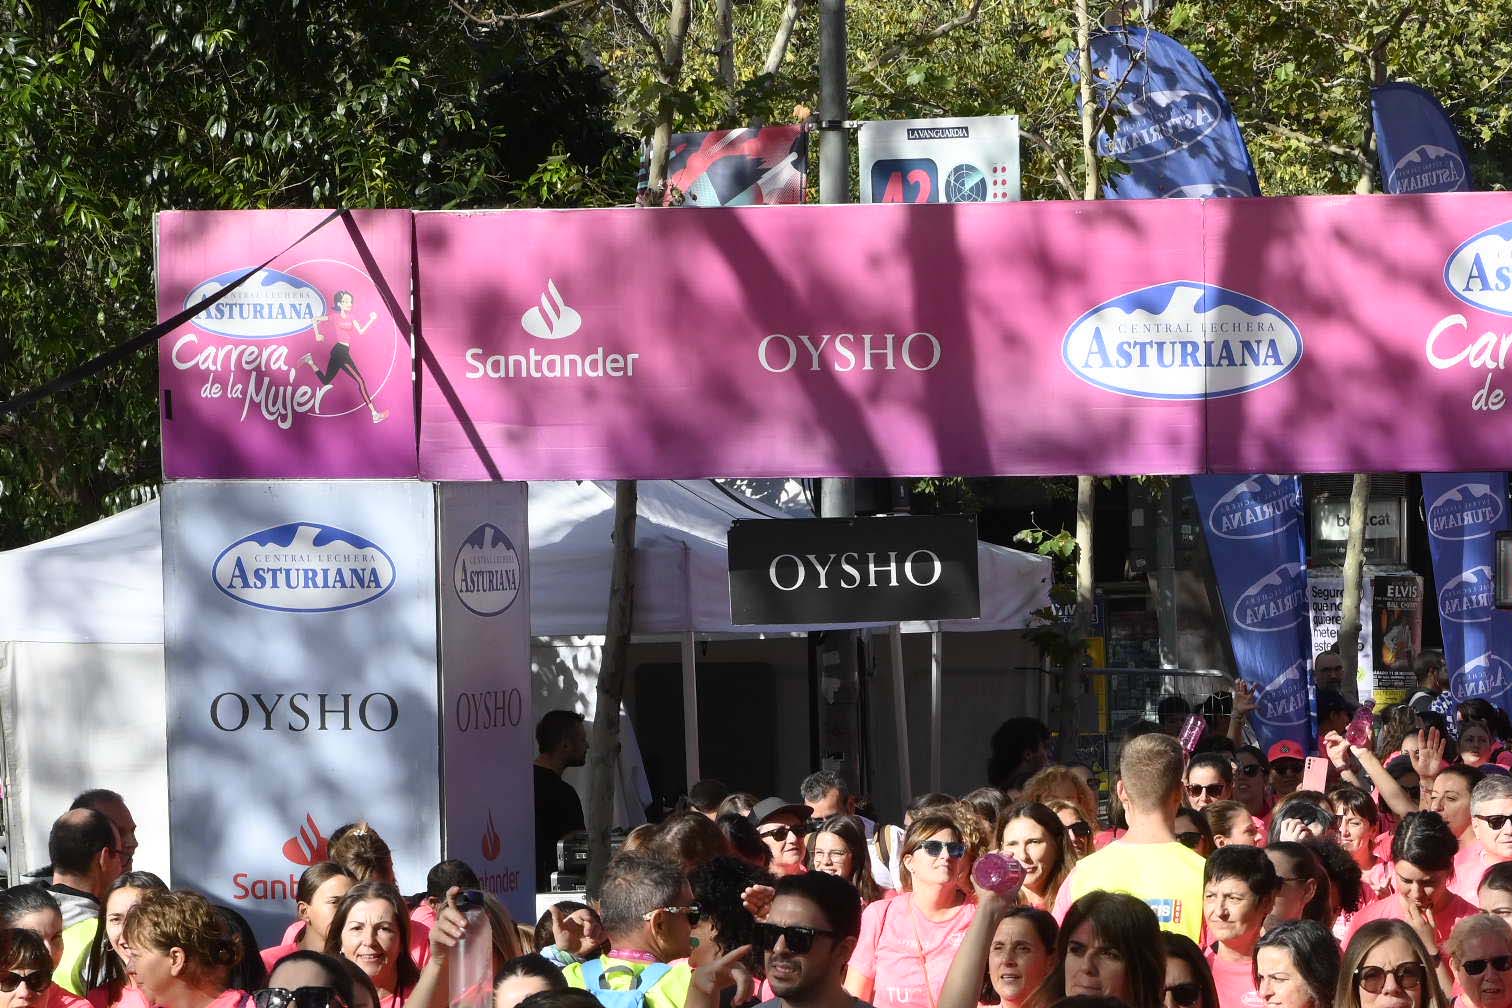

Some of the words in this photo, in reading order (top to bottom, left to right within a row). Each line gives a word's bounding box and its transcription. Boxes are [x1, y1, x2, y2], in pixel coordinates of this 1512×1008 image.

[1118, 322, 1193, 333] CENTRAL
[1201, 321, 1277, 333] LECHERA
[172, 334, 288, 371] Carrera
[465, 347, 640, 379] Santander
[758, 332, 942, 374] OYSHO
[1081, 326, 1284, 370] ASTURIANA
[201, 373, 222, 398] de
[228, 372, 242, 398] la
[241, 368, 333, 430] Mujer
[1471, 373, 1506, 411] de
[227, 556, 383, 590] ASTURIANA
[254, 554, 311, 563] CENTRAL
[317, 553, 376, 563] LECHERA
[769, 548, 943, 591] OYSHO
[460, 559, 517, 594] ASTURIANA
[1387, 586, 1418, 598] ELVIS
[1313, 615, 1345, 626] quiere
[210, 692, 398, 732] OYSHO
[456, 688, 522, 732] OYSHO
[233, 873, 300, 901] Sant
[887, 987, 908, 1003] TU
